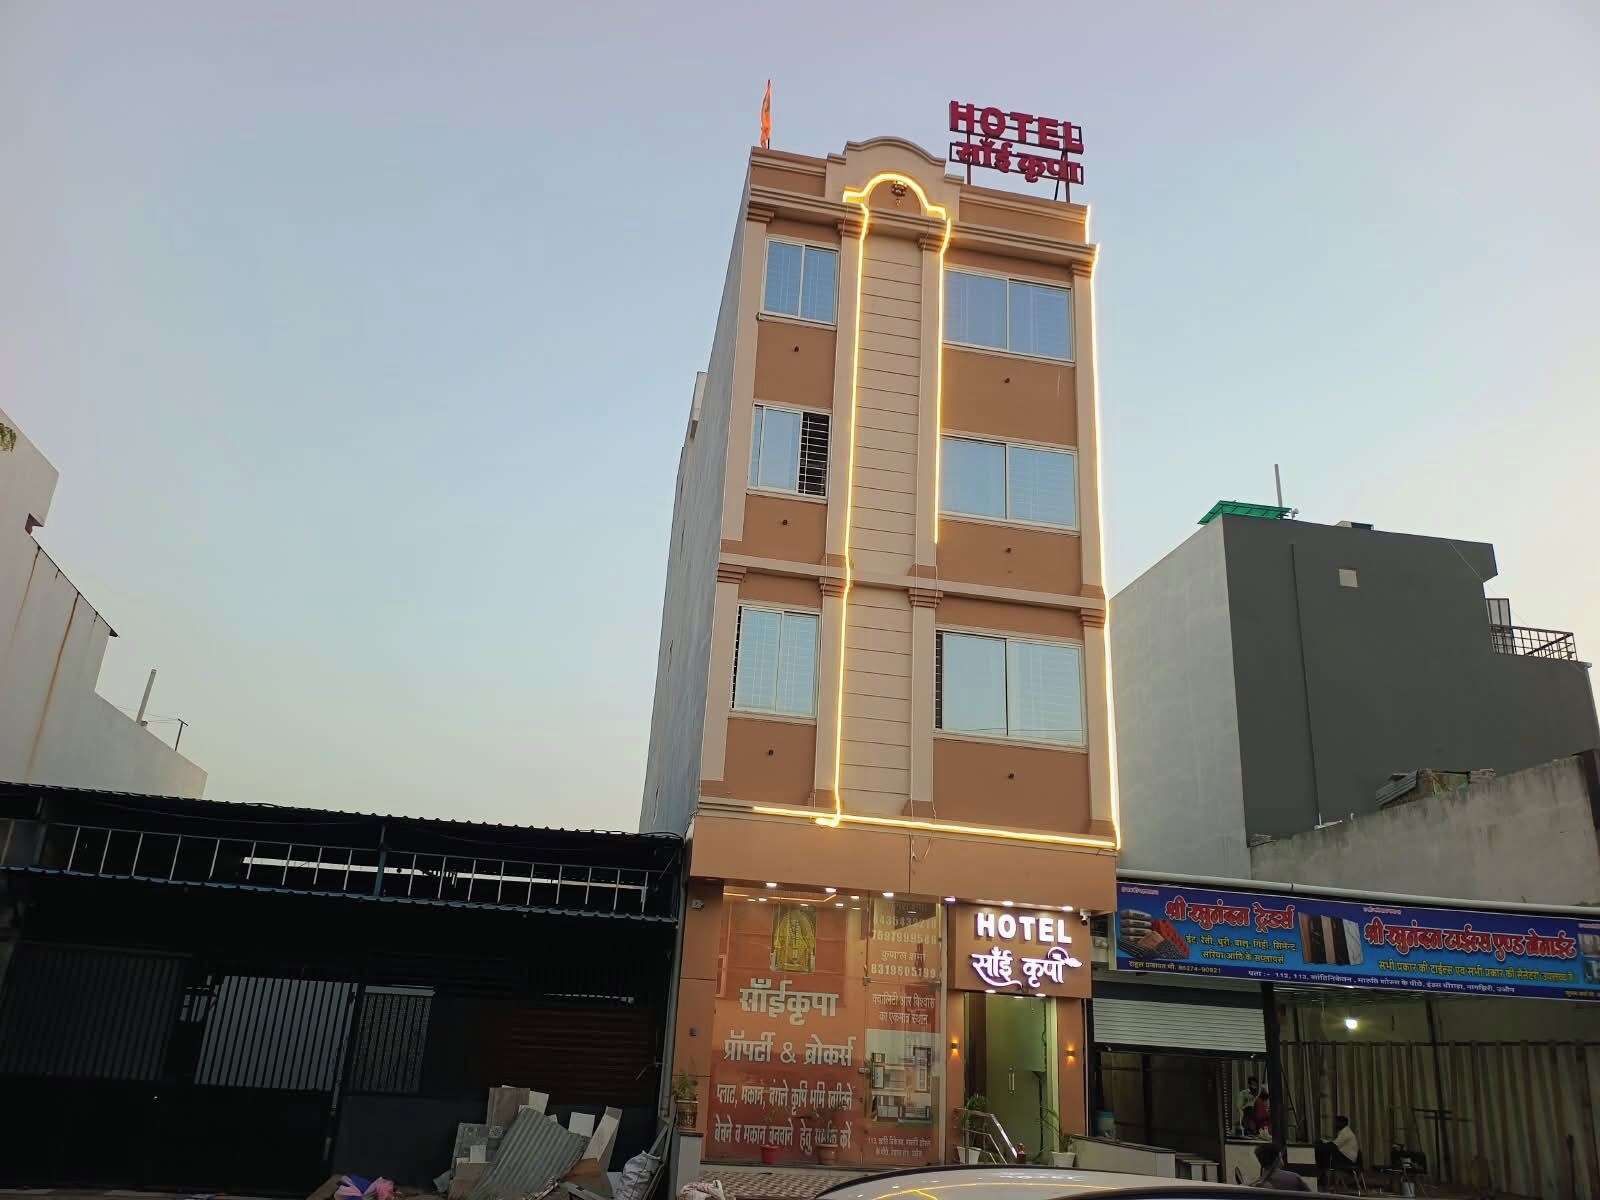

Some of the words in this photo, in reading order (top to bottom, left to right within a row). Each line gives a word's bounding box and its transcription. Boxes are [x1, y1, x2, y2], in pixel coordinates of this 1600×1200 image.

[949, 100, 1084, 154] HOTEL
[1016, 152, 1082, 183] कृपा
[1165, 896, 1186, 920] श्री
[976, 911, 1072, 944] HOTEL
[1364, 916, 1384, 944] श्री
[1021, 946, 1078, 987] कृपा
[780, 1041, 797, 1064] &
[803, 1033, 857, 1067] ब्रोकर्स
[715, 1113, 733, 1143] बेचने
[735, 1124, 742, 1142] व
[744, 1124, 767, 1144] मकान
